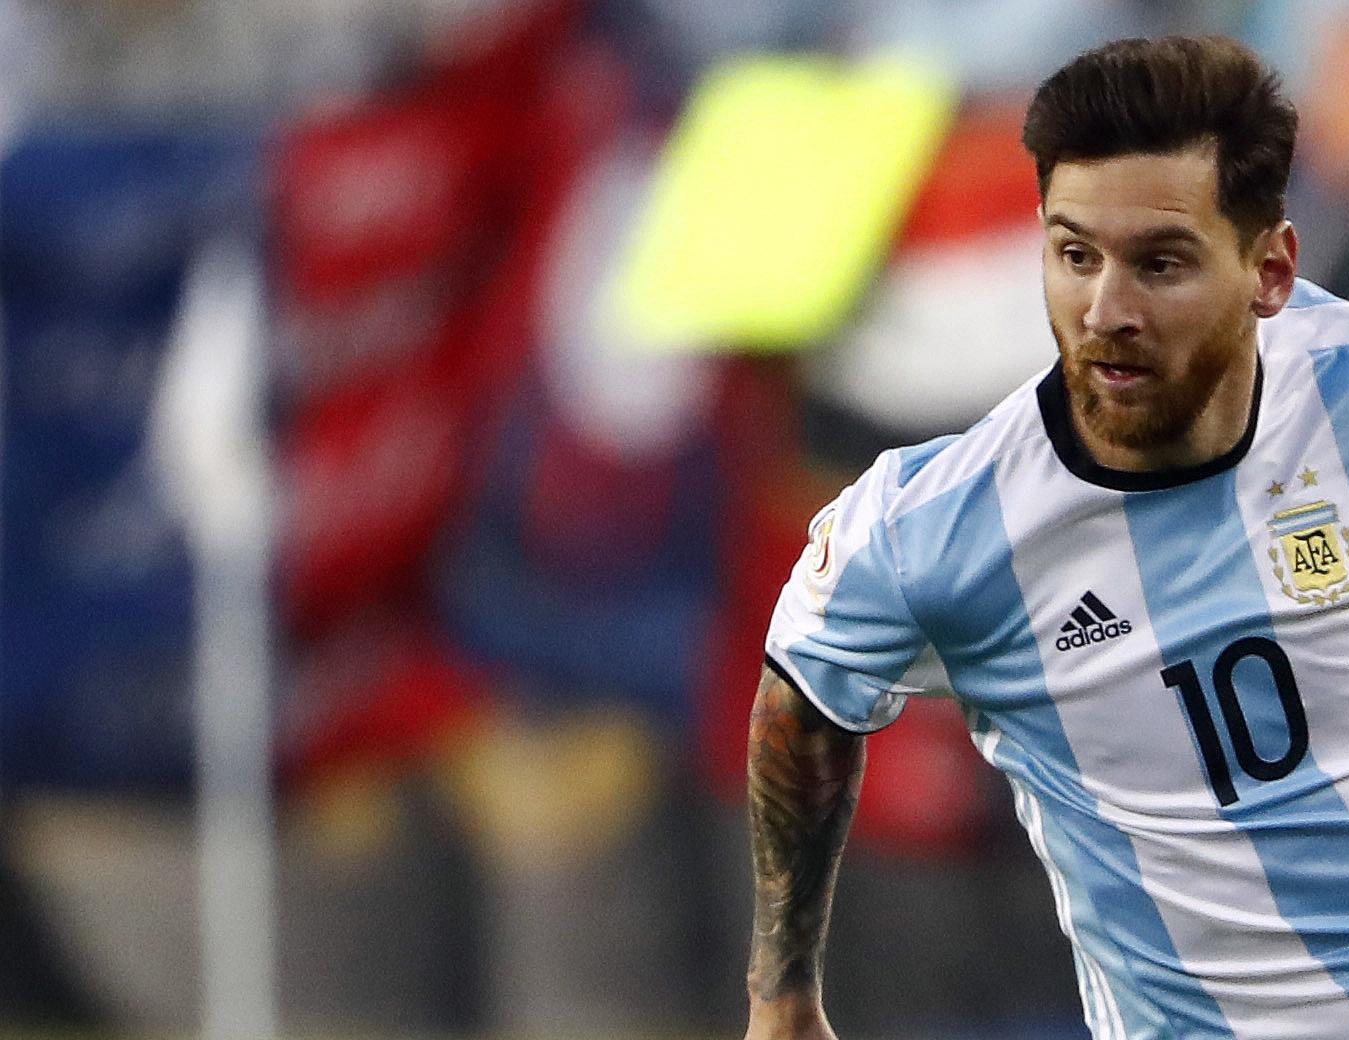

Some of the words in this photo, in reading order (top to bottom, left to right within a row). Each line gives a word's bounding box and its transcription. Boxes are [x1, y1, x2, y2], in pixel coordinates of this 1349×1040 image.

[1293, 530, 1338, 574] AFA
[1055, 619, 1132, 651] adidas
[1160, 636, 1309, 807] 10
